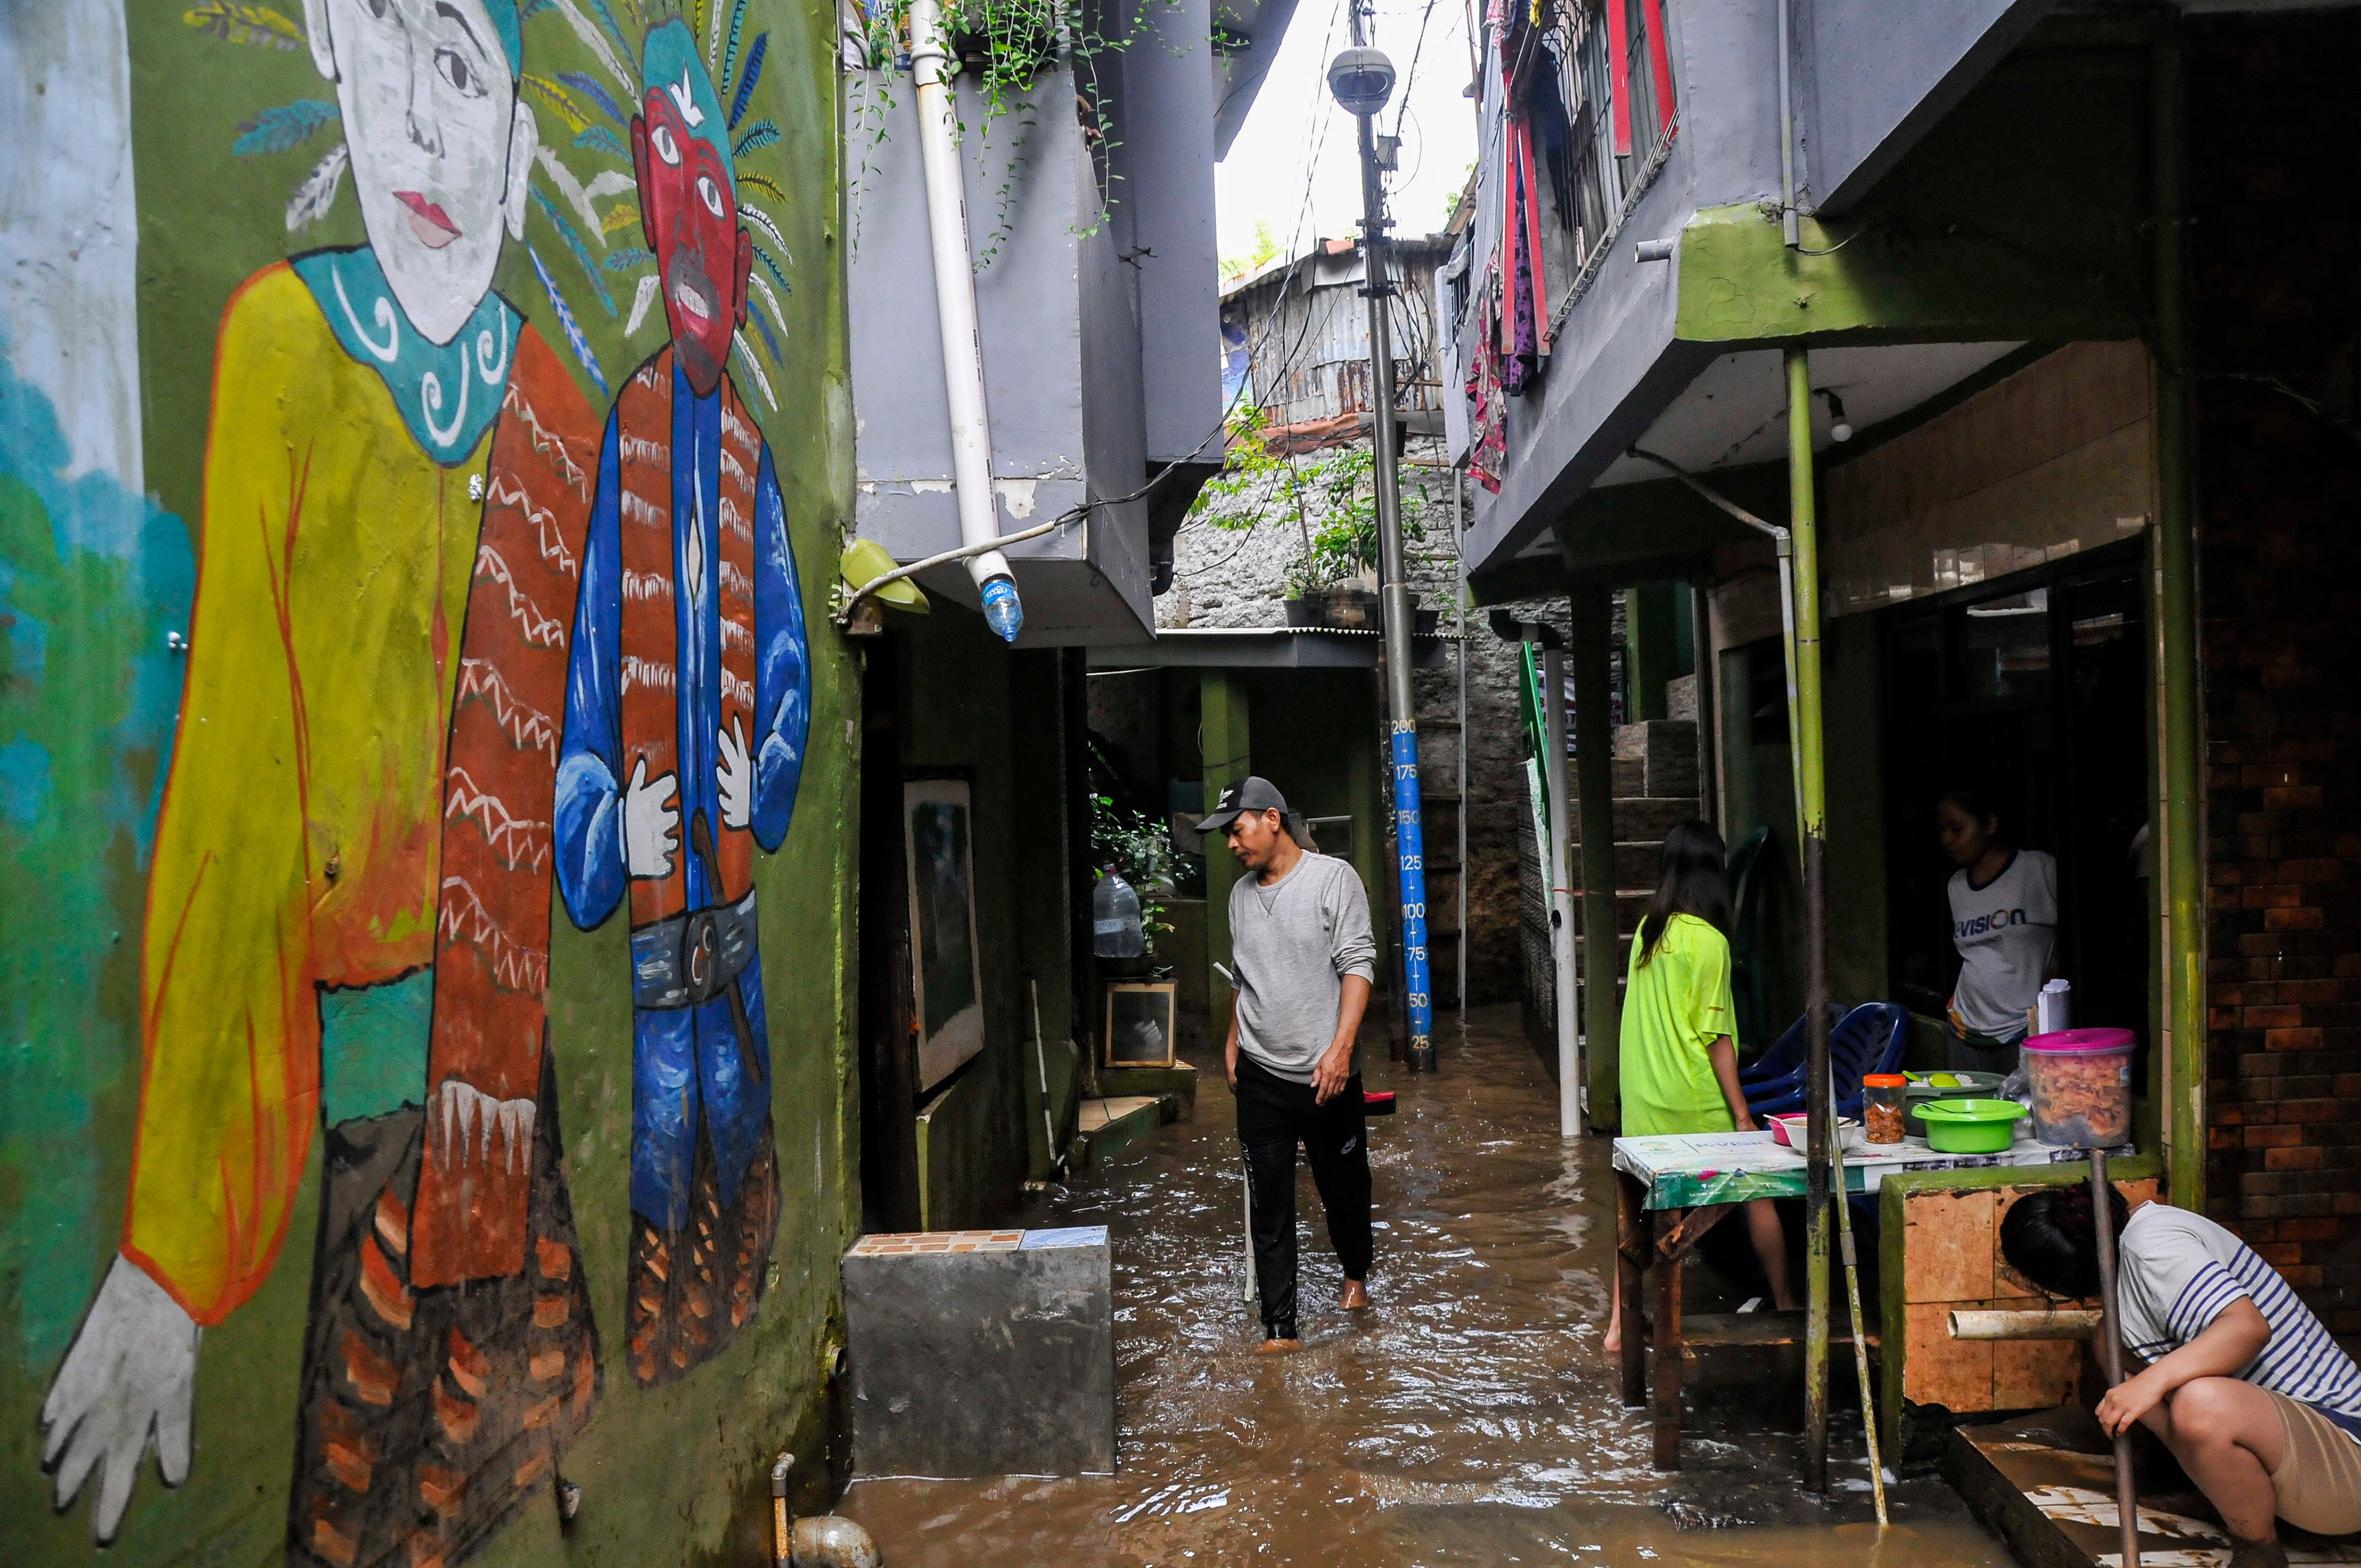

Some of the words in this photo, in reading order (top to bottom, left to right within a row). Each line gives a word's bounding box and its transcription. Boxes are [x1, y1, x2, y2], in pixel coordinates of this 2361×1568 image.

[985, 585, 1008, 599] OASIS
[1391, 719, 1416, 735] 200
[1396, 764, 1417, 780] 175
[1398, 810, 1421, 825] 150
[1400, 855, 1423, 870] 125
[1402, 902, 1425, 919] 100
[1407, 946, 1426, 961] 75
[1408, 992, 1428, 1008] 50
[1411, 1035, 1430, 1049] 25
